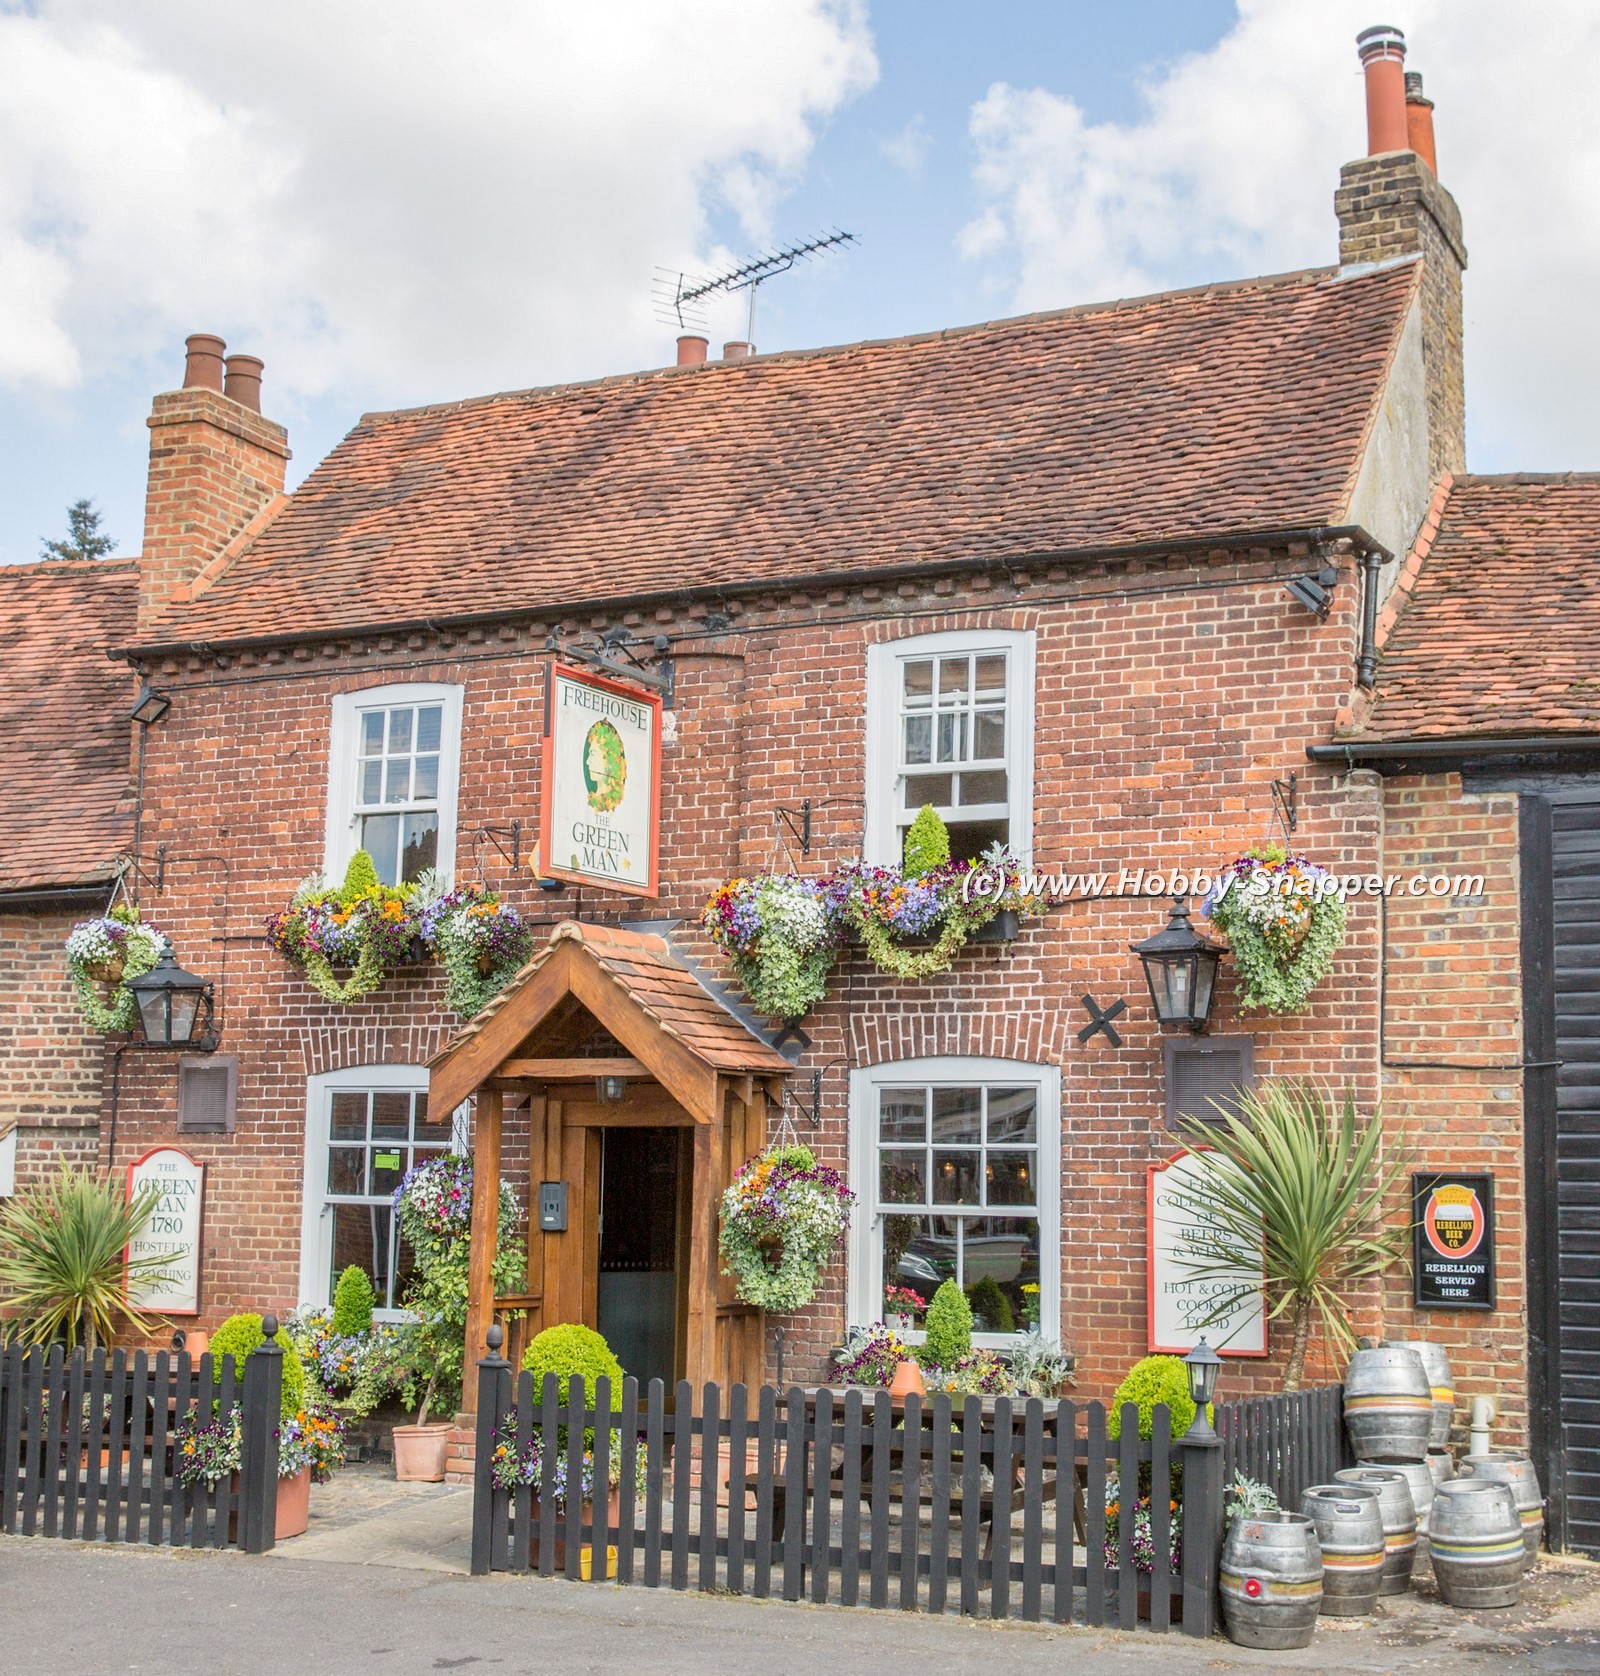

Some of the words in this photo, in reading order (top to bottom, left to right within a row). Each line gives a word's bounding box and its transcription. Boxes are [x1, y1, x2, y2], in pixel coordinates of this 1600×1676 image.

[563, 685, 647, 731] FREEHOUSE
[594, 814, 611, 828] THE
[572, 821, 630, 853] GREEN
[581, 847, 619, 873] MAN
[157, 1163, 178, 1172] THE
[138, 1178, 197, 1196] GREEN
[146, 1196, 187, 1213] AN
[1197, 1212, 1217, 1224] OF
[151, 1217, 183, 1234] 1780
[1436, 1220, 1473, 1230] REBELLION
[1181, 1228, 1233, 1241] BEERS
[1445, 1230, 1464, 1239] BEER
[134, 1241, 194, 1253] HOSTELRY
[1448, 1239, 1461, 1248] CO.
[1173, 1245, 1184, 1257] &
[1425, 1263, 1485, 1273] REBELLION
[1435, 1276, 1476, 1285] SERVED
[151, 1284, 174, 1295] INN
[1164, 1282, 1194, 1294] HOT
[1198, 1283, 1209, 1295] &
[1441, 1288, 1470, 1297] HERE
[1186, 1316, 1230, 1330] FOOD
